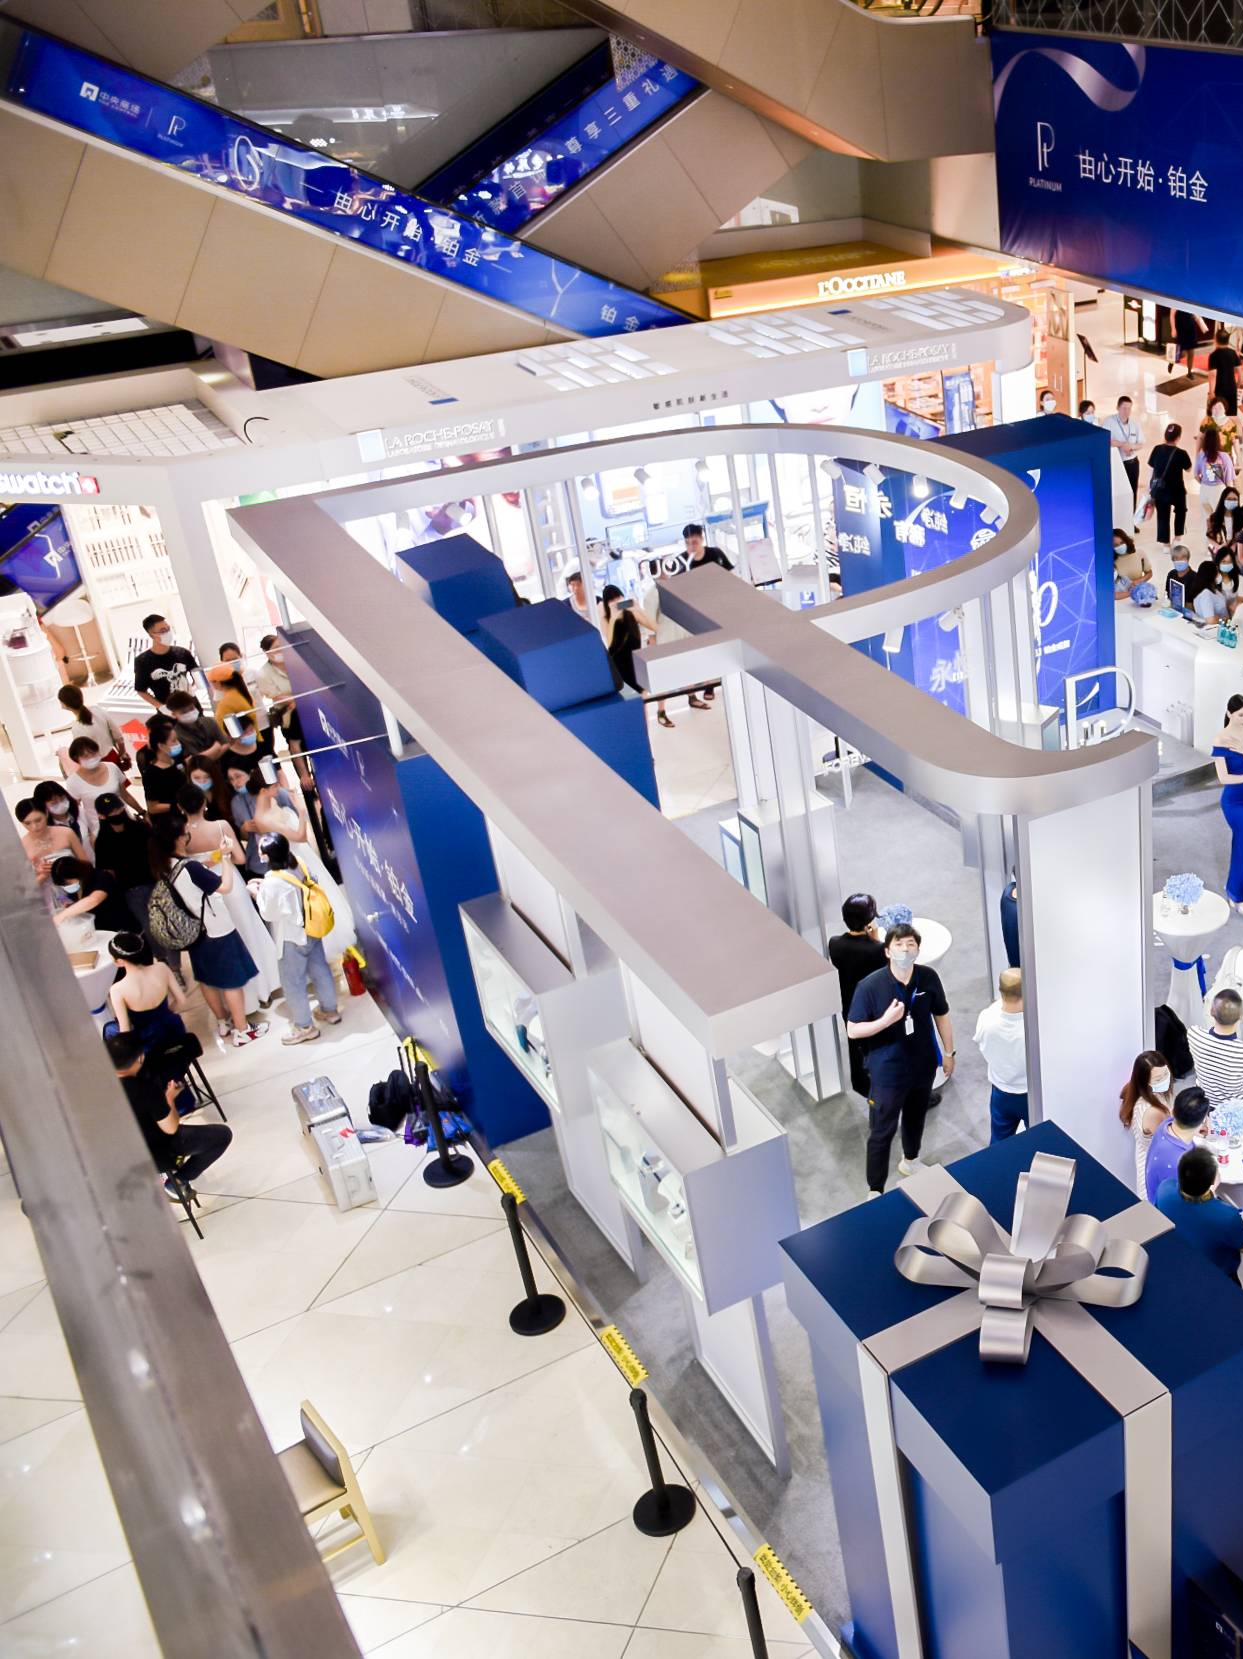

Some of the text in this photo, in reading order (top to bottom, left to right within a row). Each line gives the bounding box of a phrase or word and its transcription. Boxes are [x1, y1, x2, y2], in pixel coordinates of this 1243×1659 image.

[1028, 176, 1063, 192] PLATINUM
[1079, 151, 1209, 203] 由心开始·铂金
